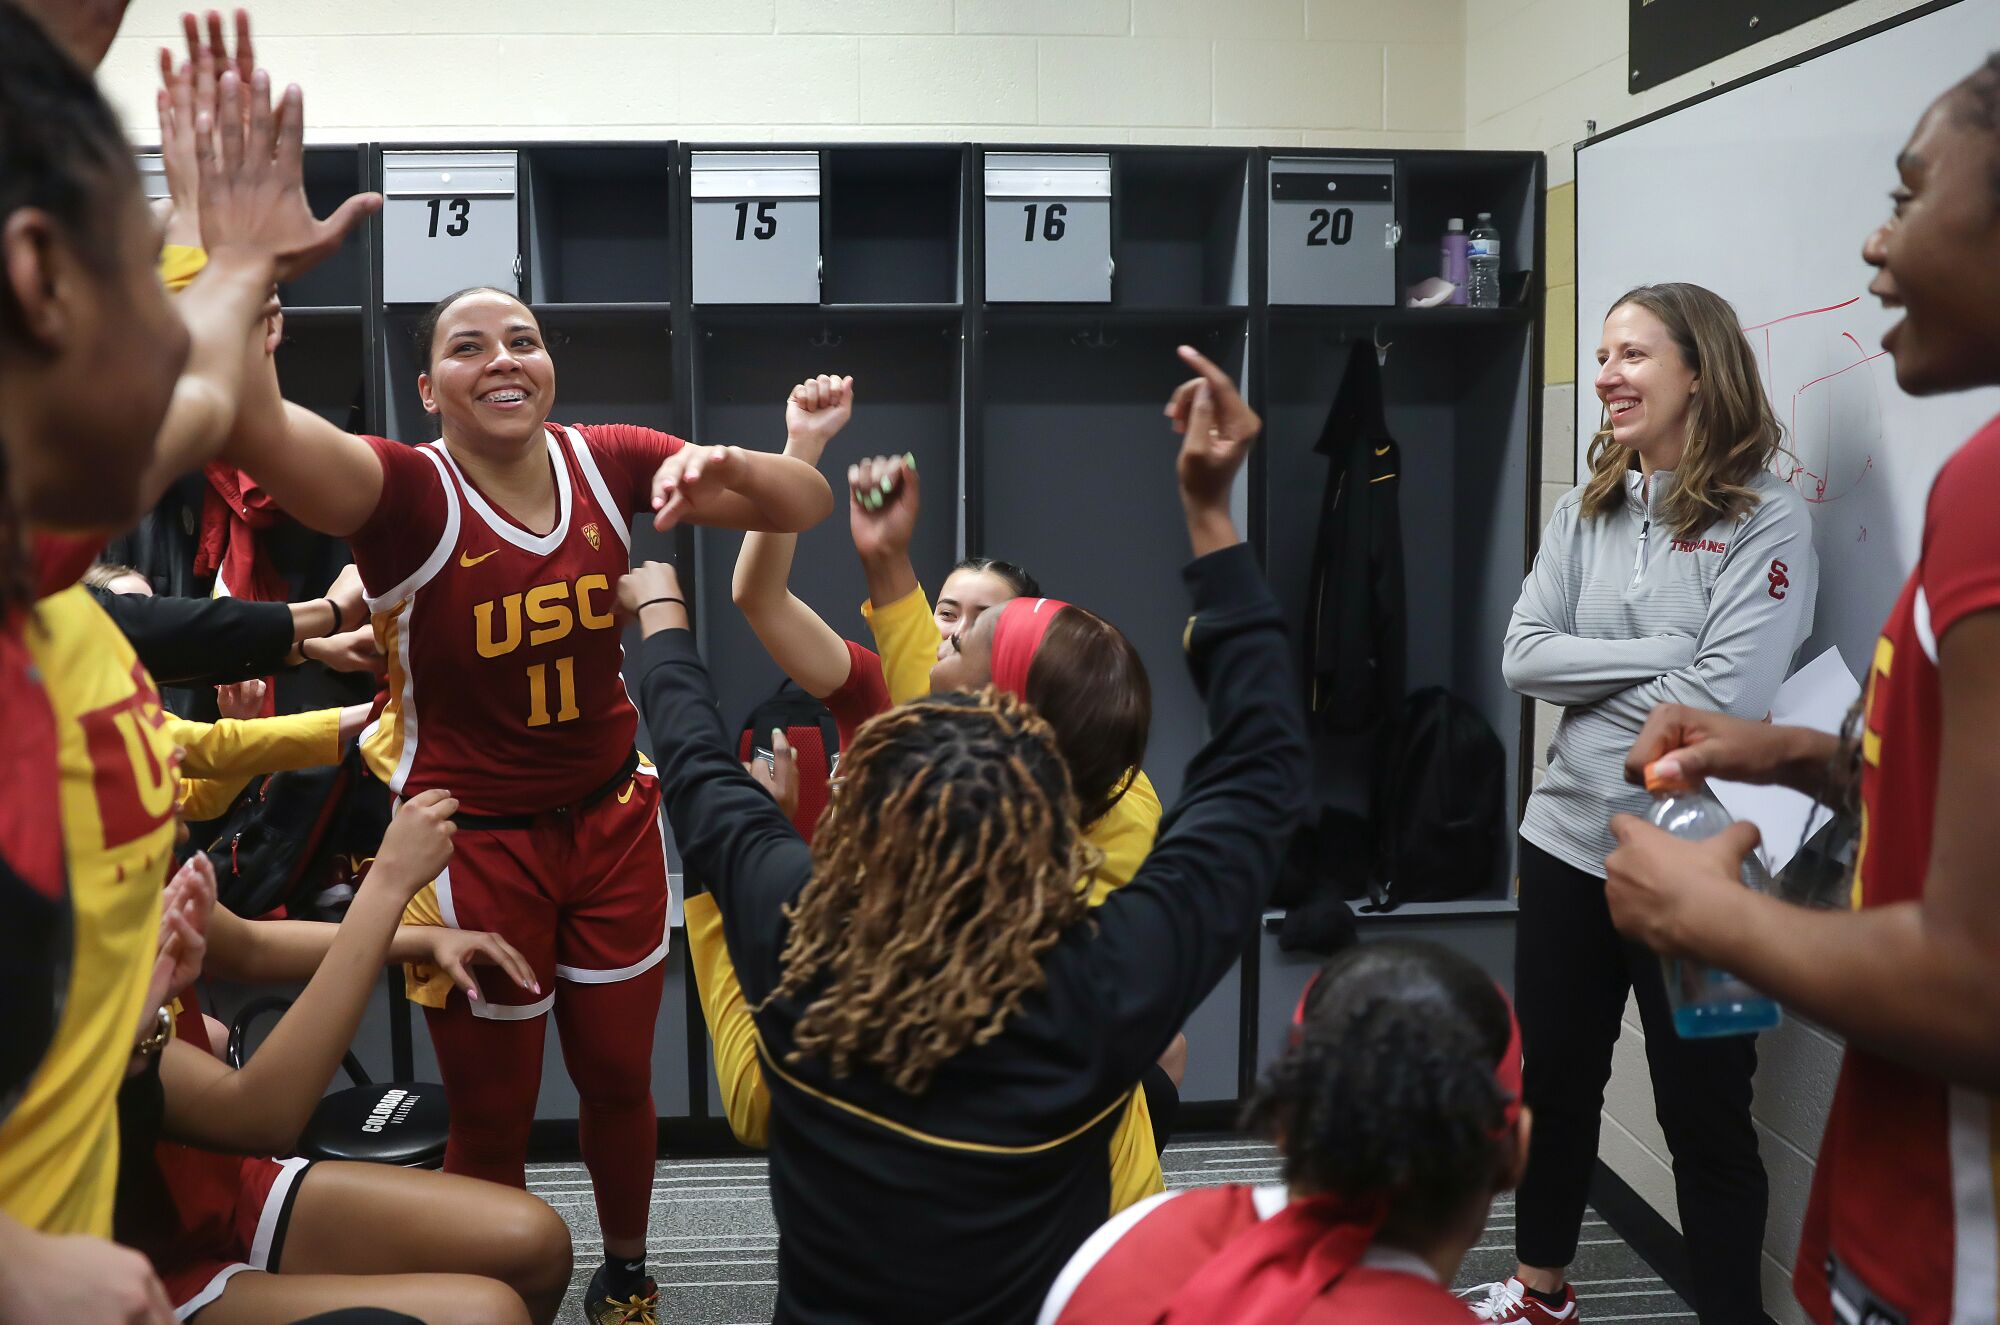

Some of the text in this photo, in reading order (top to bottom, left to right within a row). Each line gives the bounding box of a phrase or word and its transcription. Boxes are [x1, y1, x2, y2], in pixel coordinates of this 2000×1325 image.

[427, 198, 470, 237] 13
[735, 202, 778, 240] 15
[1024, 204, 1067, 241] 16
[1307, 208, 1353, 246] 20
[1671, 538, 1726, 553] TROANS
[1767, 559, 1790, 600] SC
[473, 574, 615, 659] USC
[526, 655, 580, 727] 11
[361, 1089, 408, 1133] COLORADO
